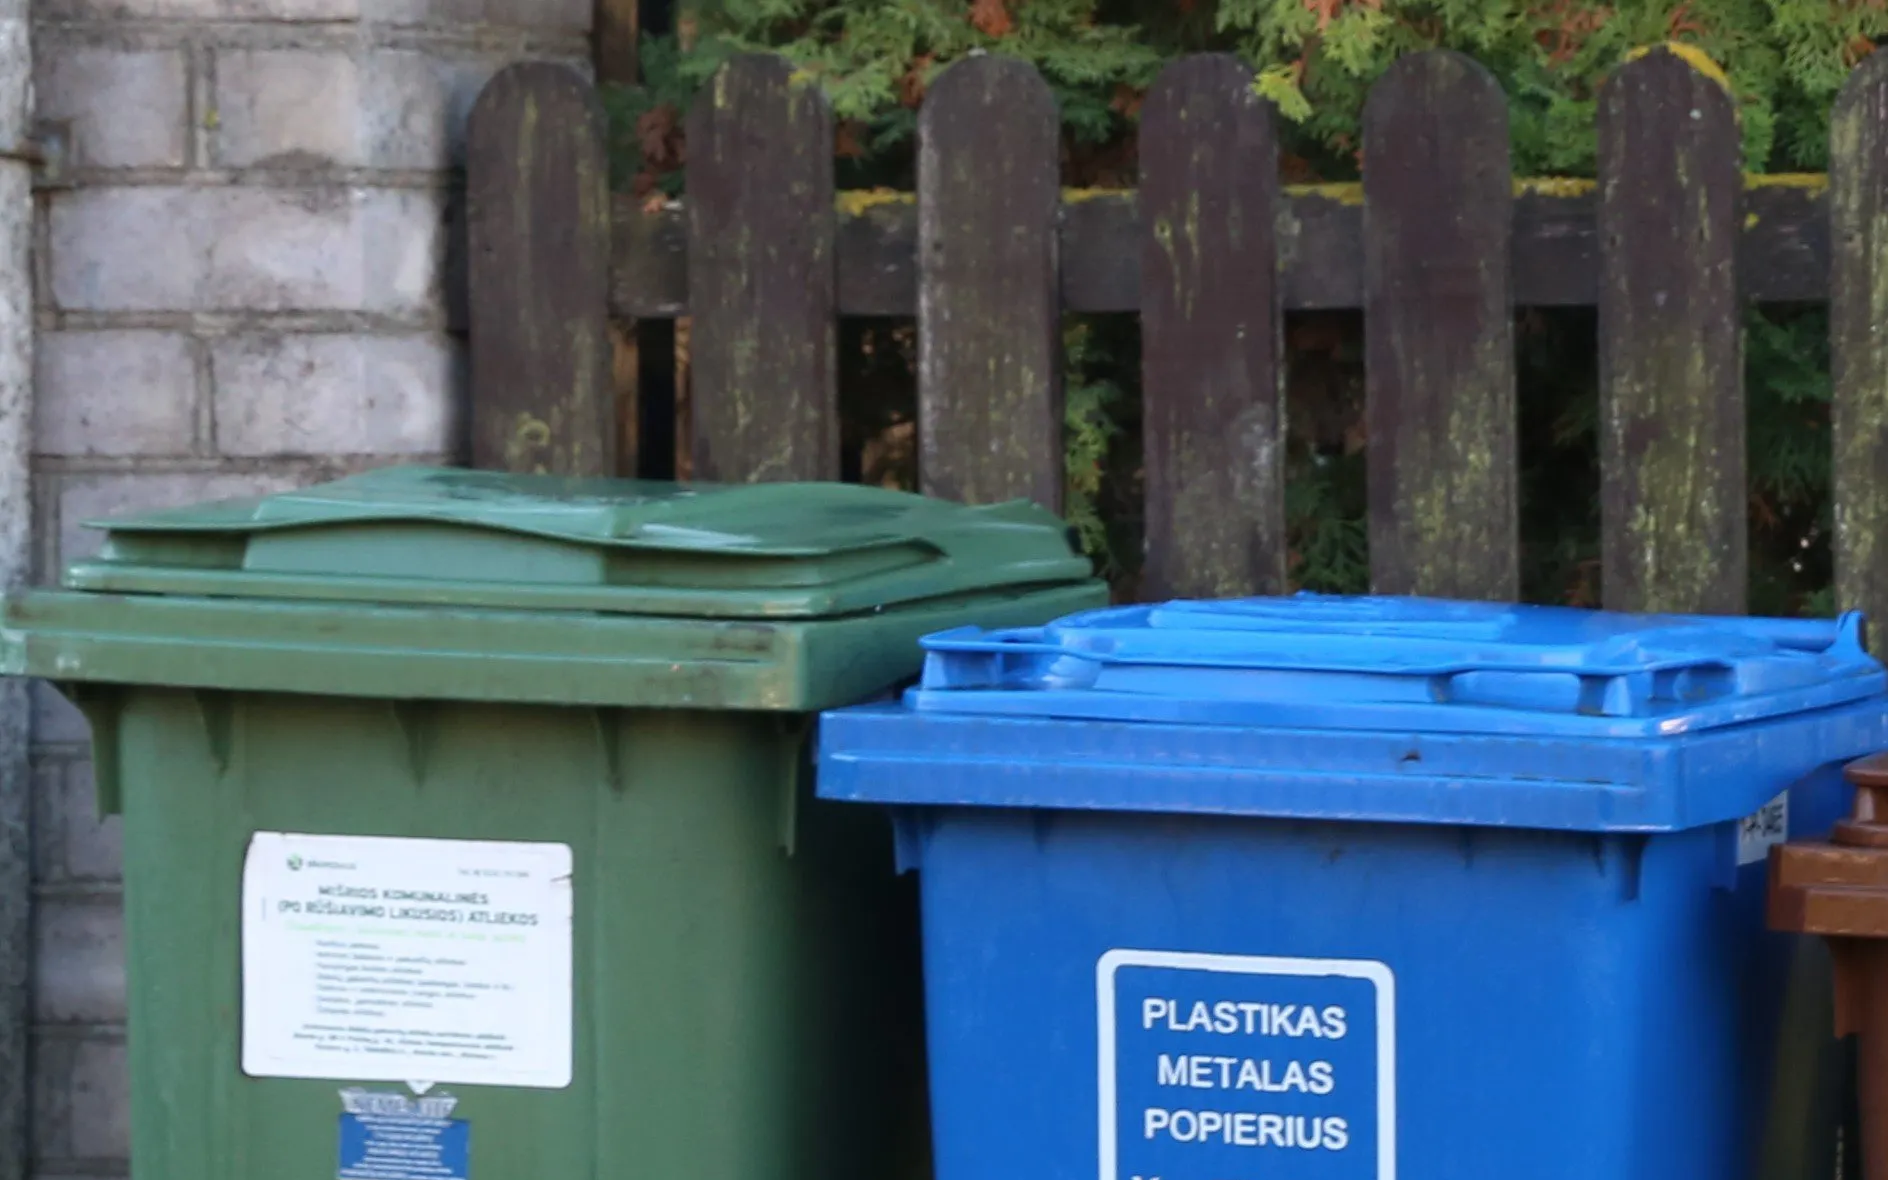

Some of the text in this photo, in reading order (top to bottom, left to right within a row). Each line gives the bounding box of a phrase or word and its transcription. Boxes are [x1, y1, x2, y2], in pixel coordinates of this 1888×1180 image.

[383, 888, 489, 905] KOMUNALINĖS
[468, 911, 539, 926] ATLIEKOS
[1144, 999, 1346, 1038] PLASTIKAS
[1158, 1055, 1333, 1094] METALAS
[1145, 1109, 1348, 1149] POPIERIUS
